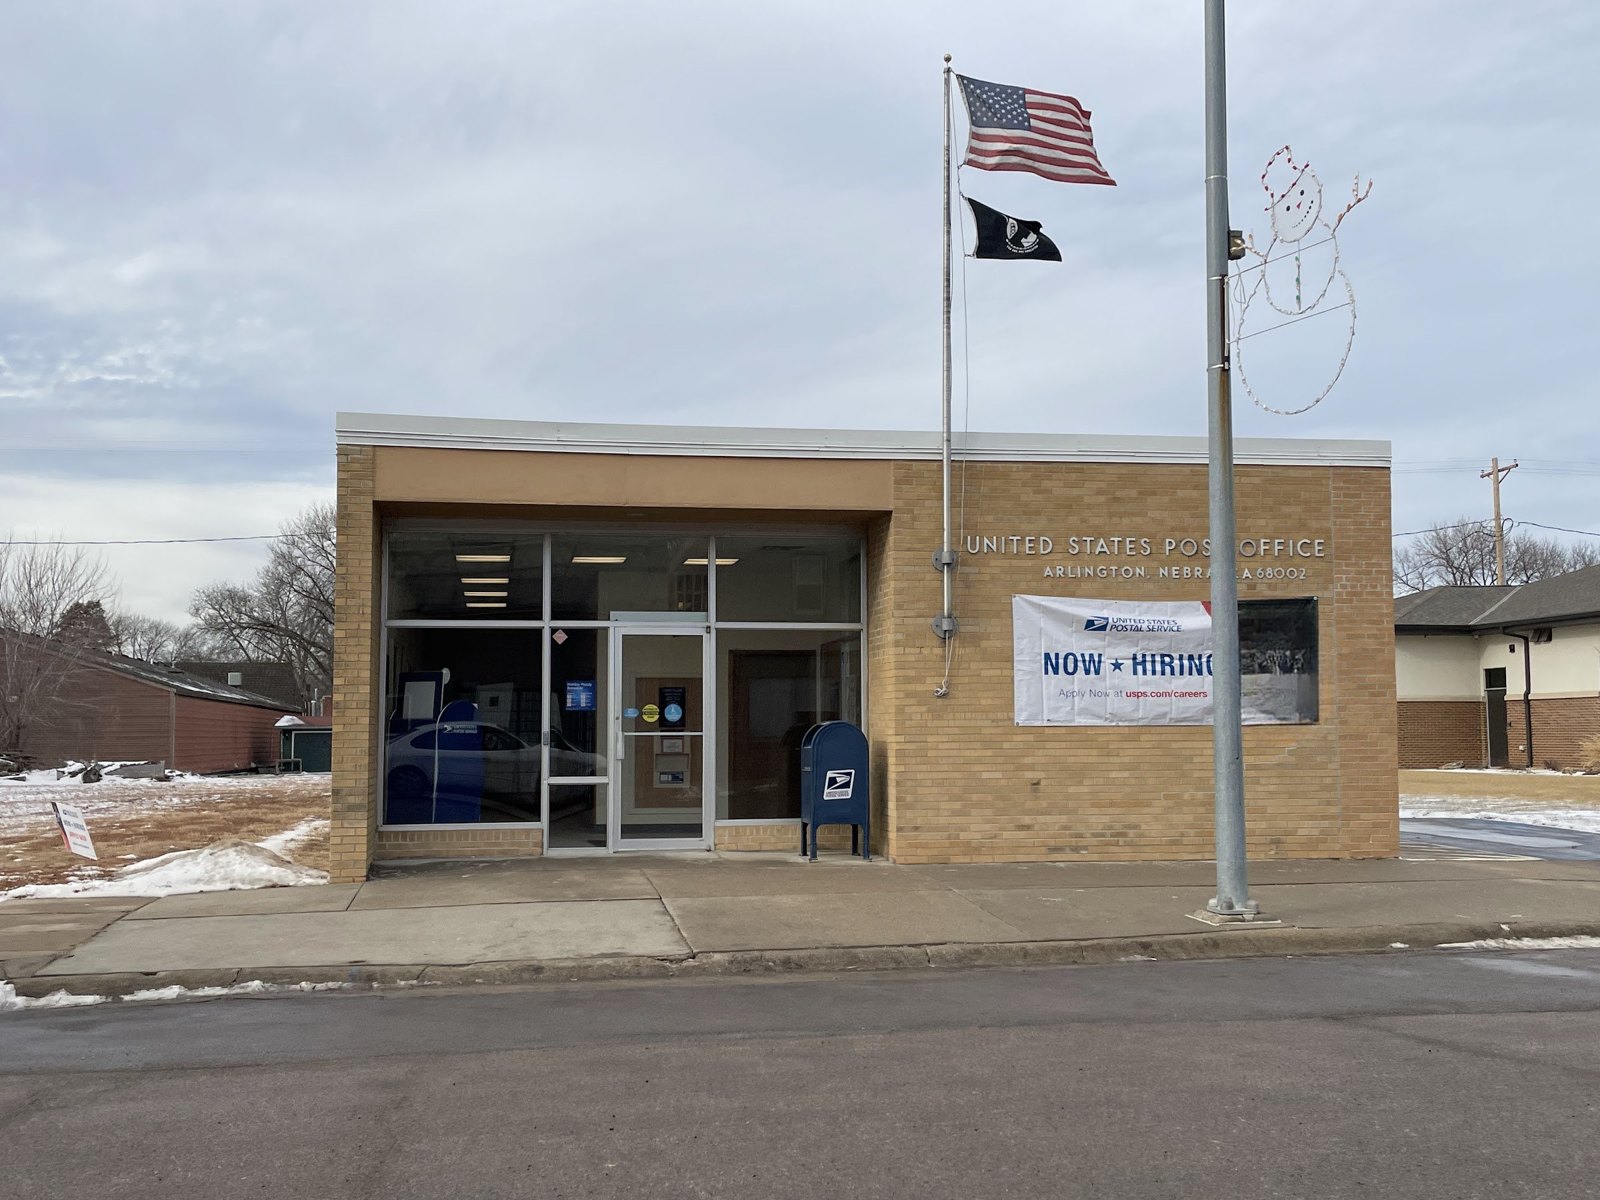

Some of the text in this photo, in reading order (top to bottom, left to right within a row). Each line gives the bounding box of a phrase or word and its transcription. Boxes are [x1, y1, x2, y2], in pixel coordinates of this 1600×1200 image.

[967, 535, 1325, 557] UNITED STATES POS OFFICE
[1159, 566, 1253, 579] NEBRA
[1256, 567, 1306, 579] 68002
[1109, 624, 1182, 633] POSTAL SERVICE
[1043, 652, 1103, 676] NOW
[1058, 688, 1208, 699] Apply Now at usps.com/careers
